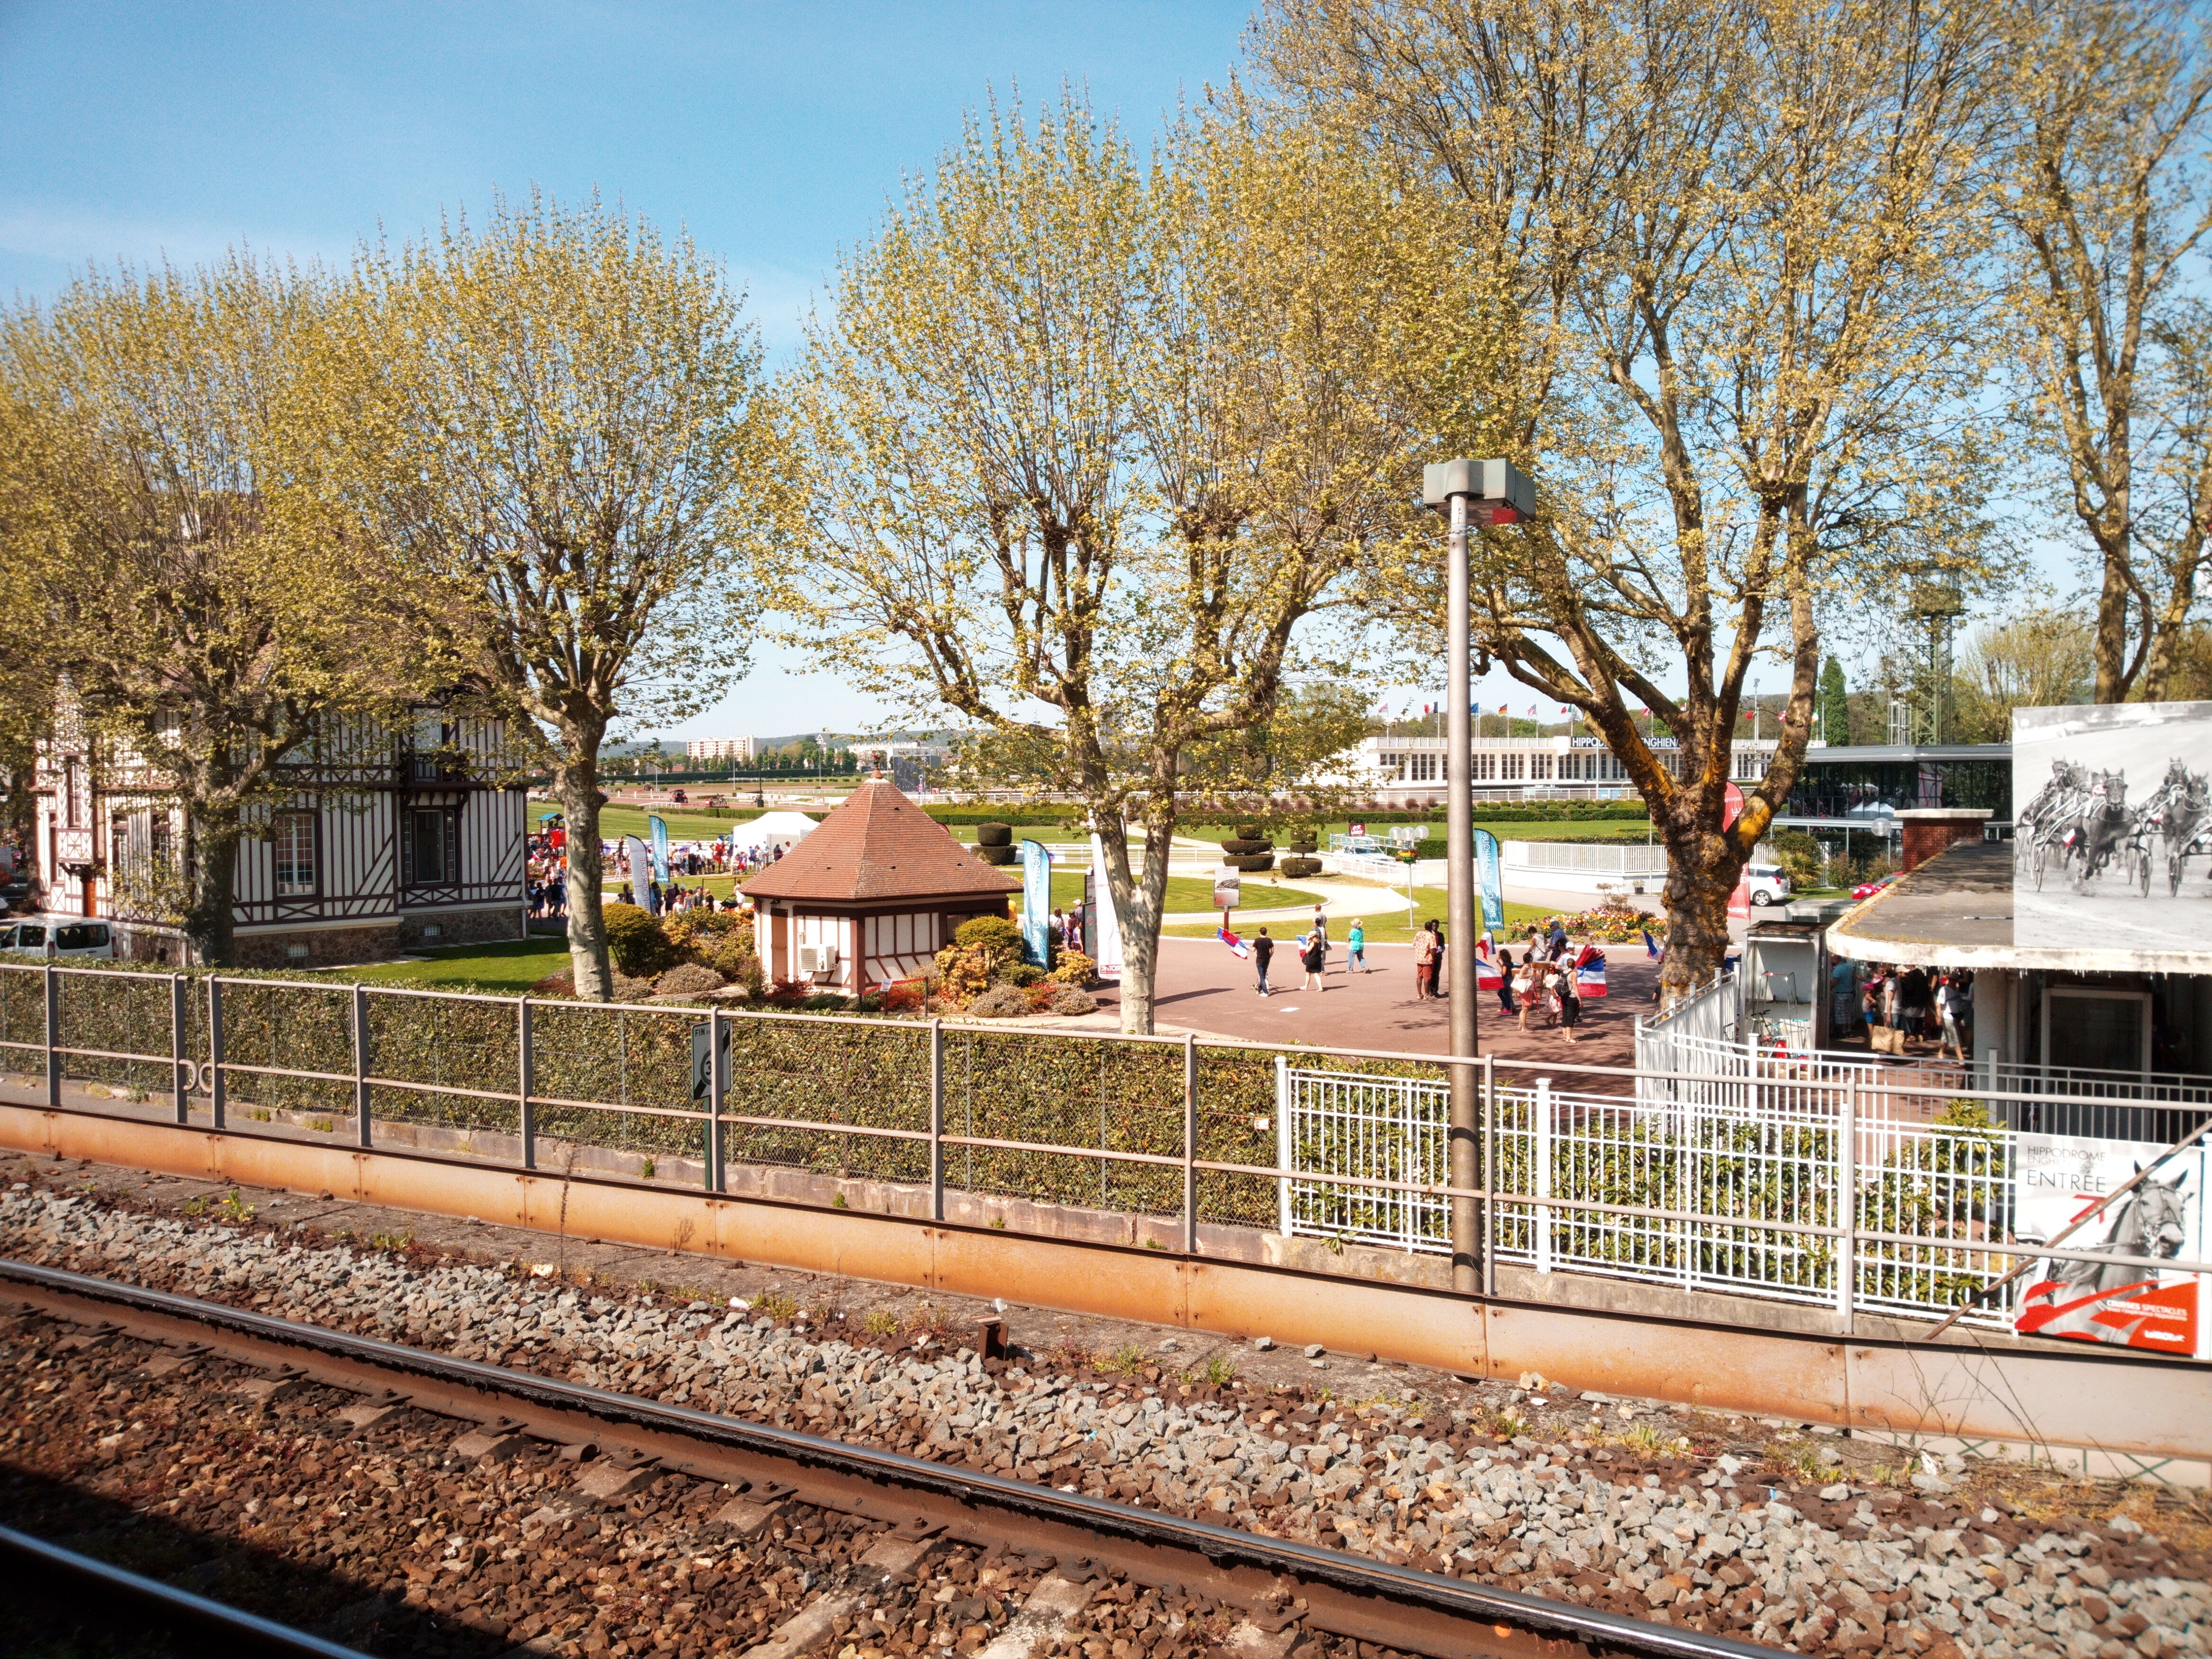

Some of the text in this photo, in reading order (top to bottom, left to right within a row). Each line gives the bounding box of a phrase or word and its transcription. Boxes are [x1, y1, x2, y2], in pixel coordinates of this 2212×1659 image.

[1572, 737, 1682, 747] HIPPOD NGHIEN/
[695, 1028, 705, 1037] FIN
[706, 1060, 711, 1076] 3
[2028, 1145, 2106, 1161] HIPPODROME
[2028, 1169, 2106, 1192] ENTRÉE
[2106, 1299, 2140, 1310] COURSES
[2141, 1303, 2188, 1316] SPECTACLES
